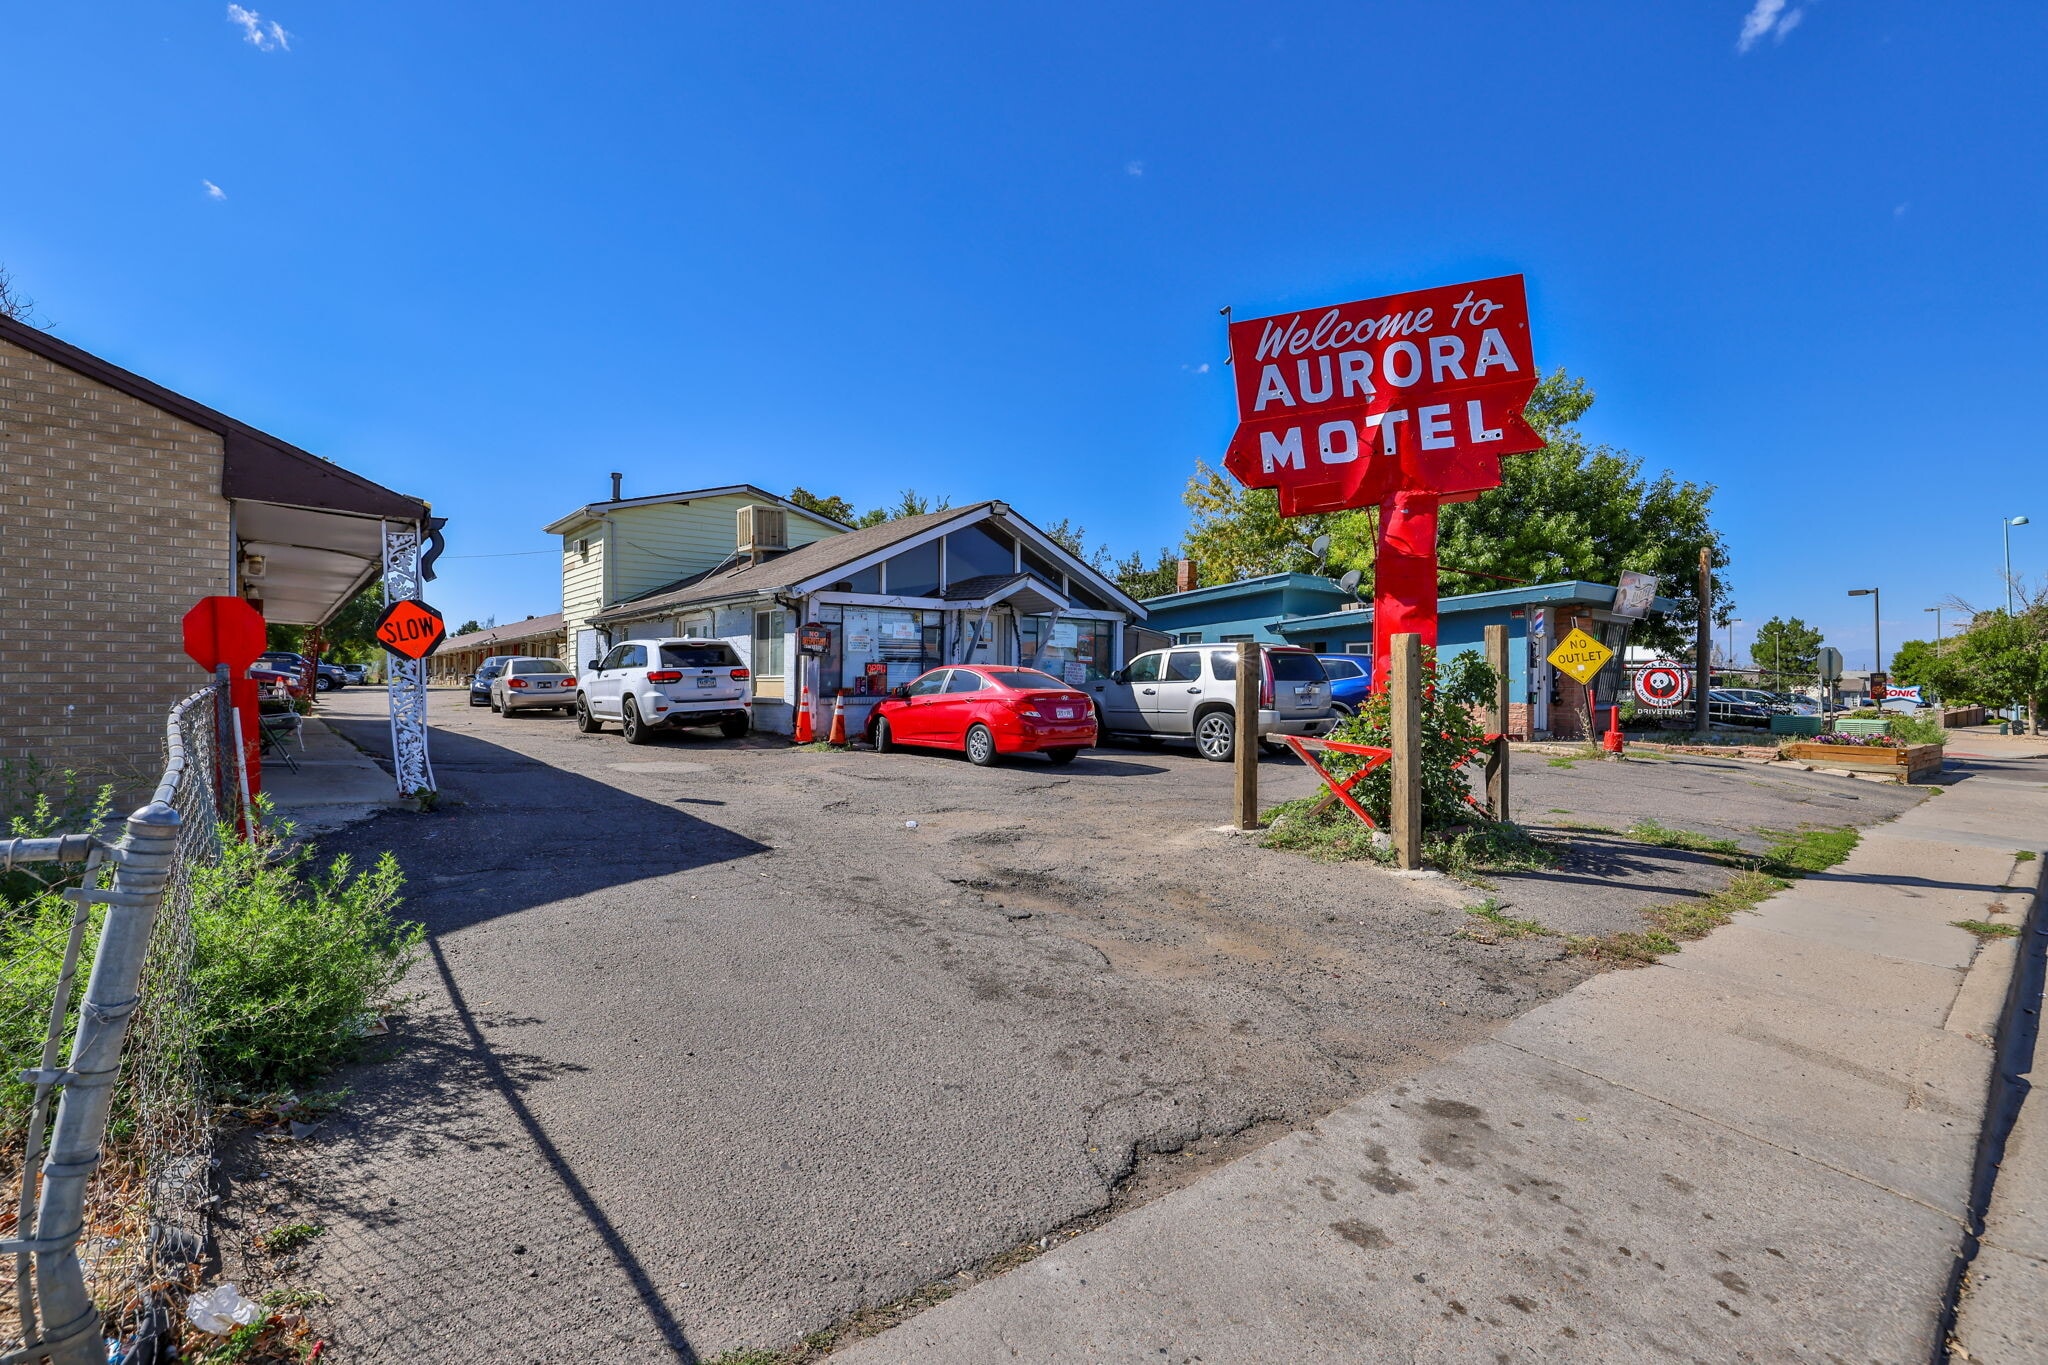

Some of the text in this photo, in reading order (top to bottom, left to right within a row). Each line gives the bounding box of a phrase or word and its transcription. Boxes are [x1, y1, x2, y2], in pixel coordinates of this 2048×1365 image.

[1255, 290, 1503, 361] Welcome to
[1254, 328, 1519, 411] AURORA
[1260, 400, 1503, 474] MOTEL
[383, 616, 434, 643] SLOW
[1557, 650, 1602, 664] OUTLET
[1569, 639, 1587, 649] NO
[1637, 662, 1656, 681] PANDA
